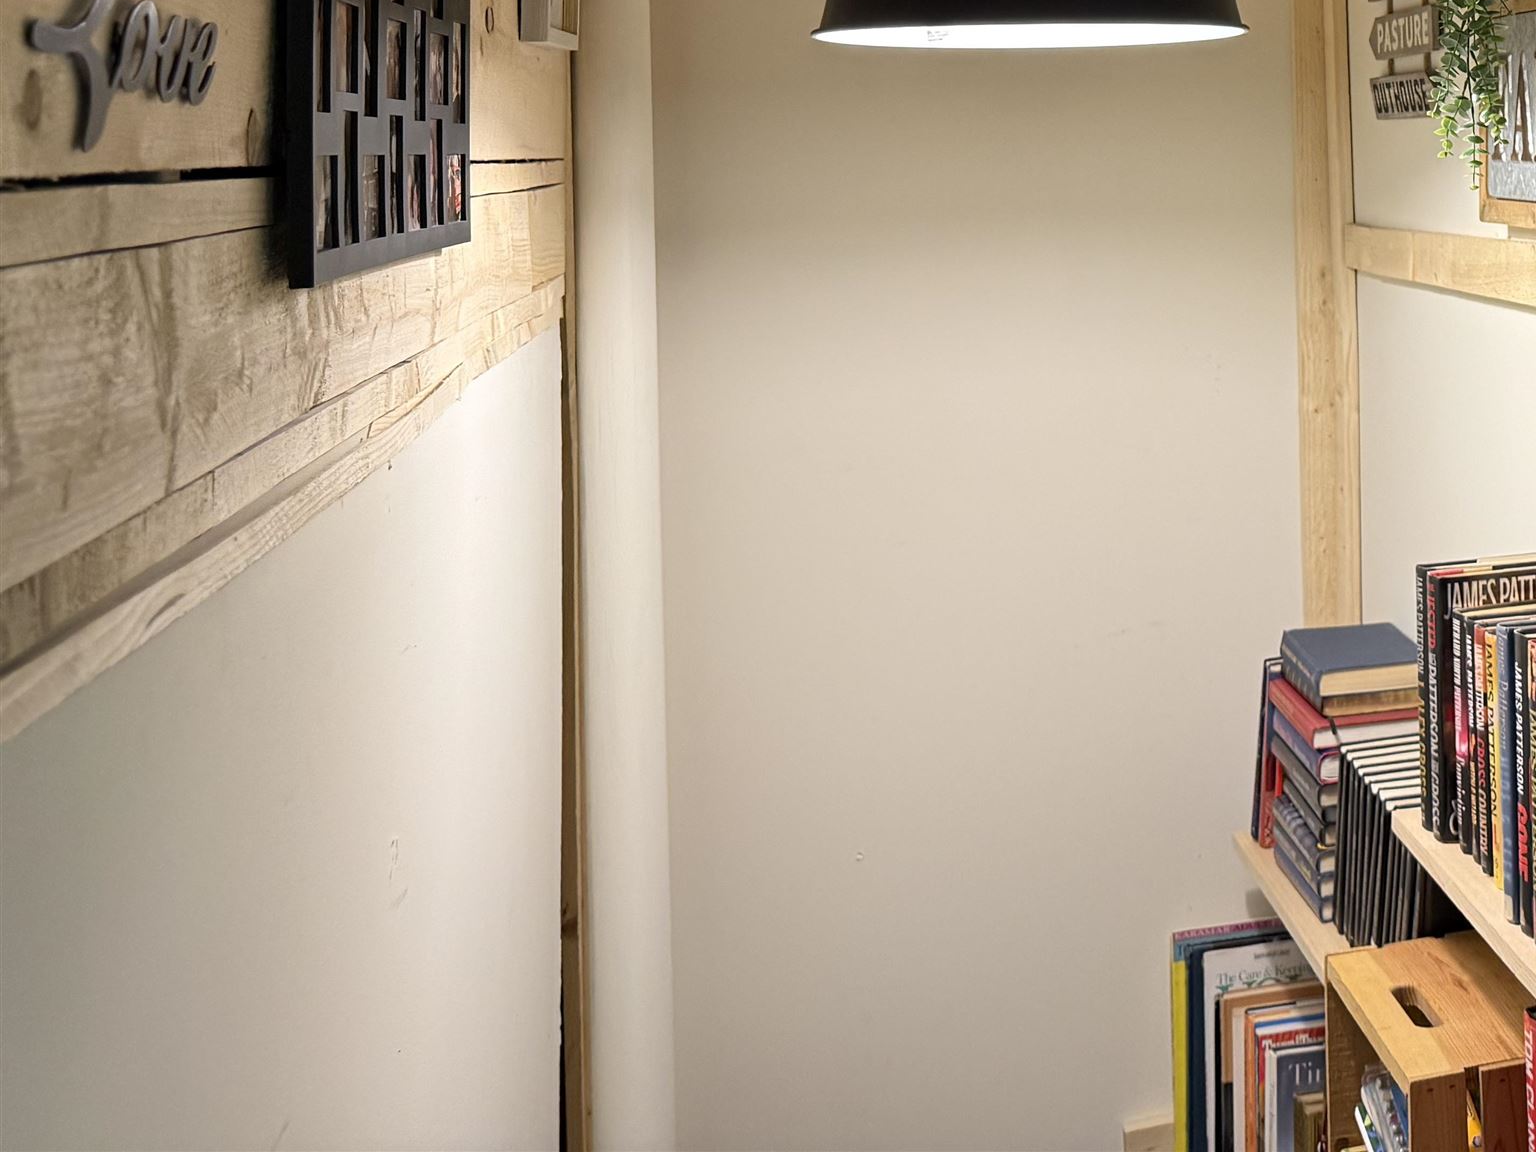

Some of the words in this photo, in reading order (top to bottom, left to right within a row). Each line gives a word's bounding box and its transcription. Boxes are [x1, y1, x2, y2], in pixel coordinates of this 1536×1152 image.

[1377, 11, 1430, 54] PASTURE
[1373, 77, 1431, 114] OUTHOUSE
[1416, 577, 1424, 612] JAMES
[1444, 579, 1497, 619] JAMES
[1417, 612, 1425, 675] PATTERSON
[1467, 669, 1475, 728] PATTERSON
[1486, 643, 1494, 702] JAMES
[1514, 661, 1523, 711] JAMES
[1487, 707, 1497, 816] PATTERSON
[1515, 712, 1524, 796] PATTERSON
[1478, 788, 1488, 856] COUNTRY
[1517, 801, 1530, 883] GONE
[1217, 971, 1237, 986] The
[1239, 969, 1259, 982] Care
[1524, 1029, 1534, 1081] TOM
